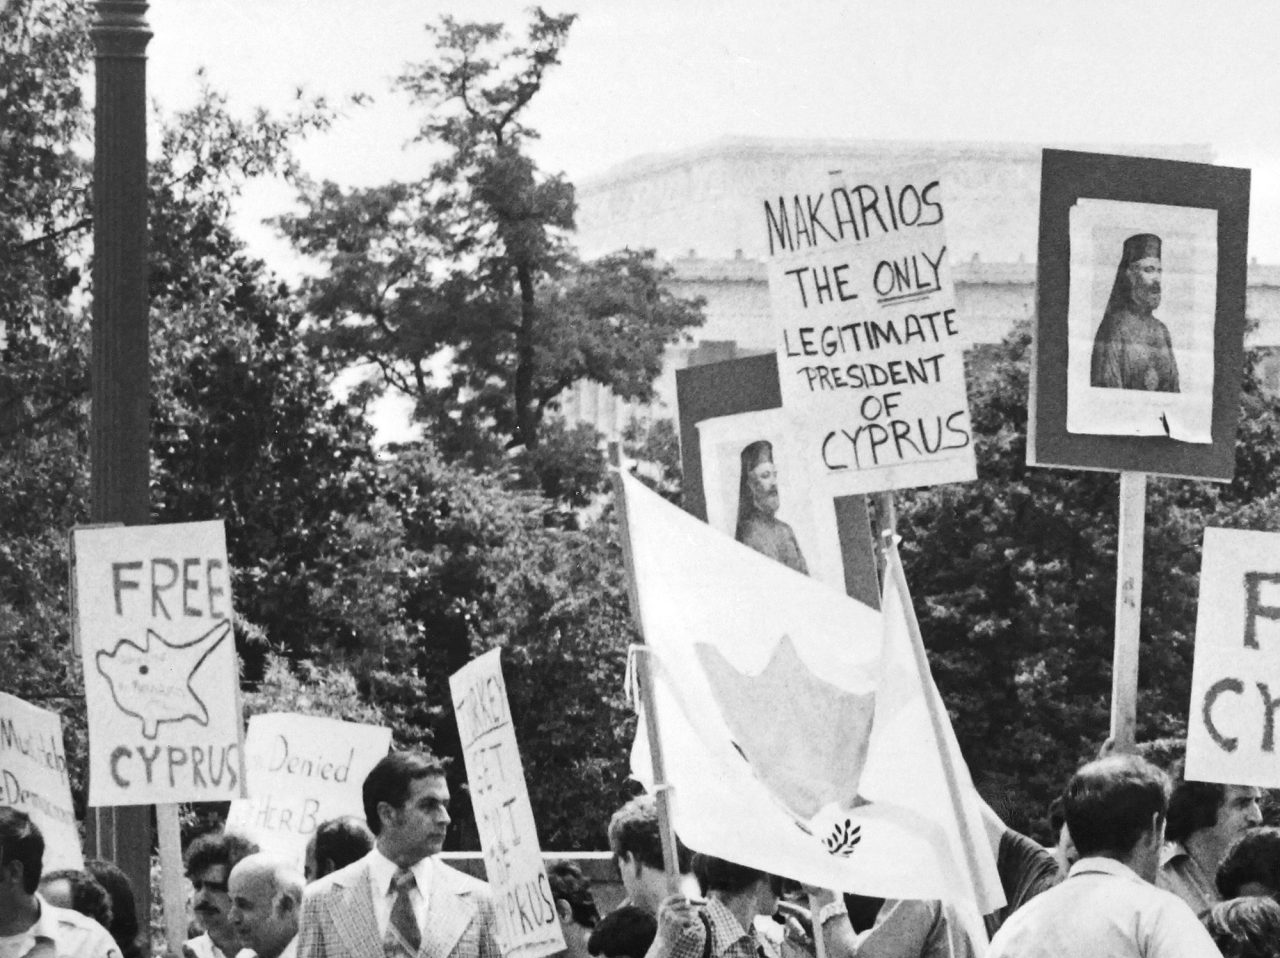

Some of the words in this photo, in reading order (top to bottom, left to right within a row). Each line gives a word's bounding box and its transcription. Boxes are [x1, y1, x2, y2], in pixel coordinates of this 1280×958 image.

[785, 264, 858, 308] THE
[873, 246, 947, 297] ONLY
[784, 308, 958, 357] LEGITIMATE
[797, 353, 945, 391] PRESIDENT
[861, 391, 902, 421] OF
[822, 411, 970, 470] CYPRUS
[111, 557, 224, 620] FREE
[110, 743, 238, 792] CYPRUS
[269, 734, 355, 784] Denied
